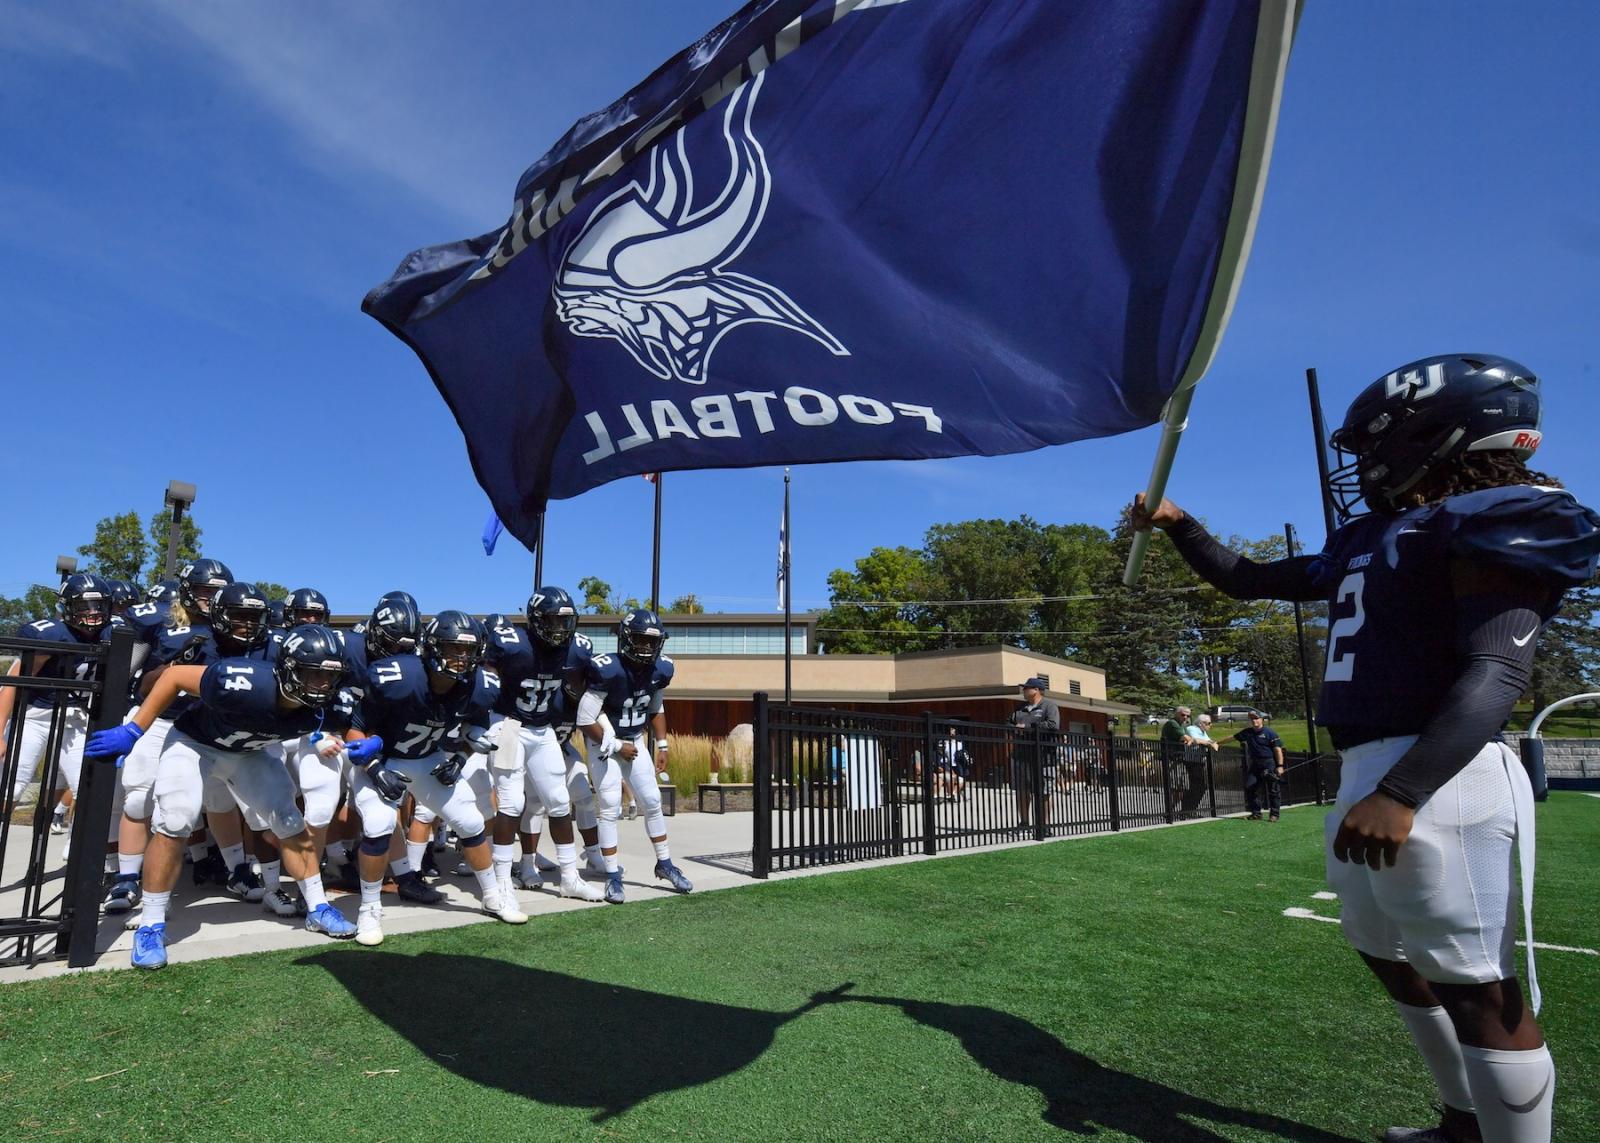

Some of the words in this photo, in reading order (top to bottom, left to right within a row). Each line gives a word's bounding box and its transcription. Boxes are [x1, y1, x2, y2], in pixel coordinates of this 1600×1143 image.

[377, 607, 396, 626] 67
[1324, 571, 1366, 681] 2
[283, 632, 304, 654] 14
[494, 626, 520, 643] 37
[225, 666, 254, 691] 14
[377, 661, 403, 684] 71
[516, 679, 563, 712] 37
[619, 695, 651, 727] 12
[394, 722, 446, 756] 71
